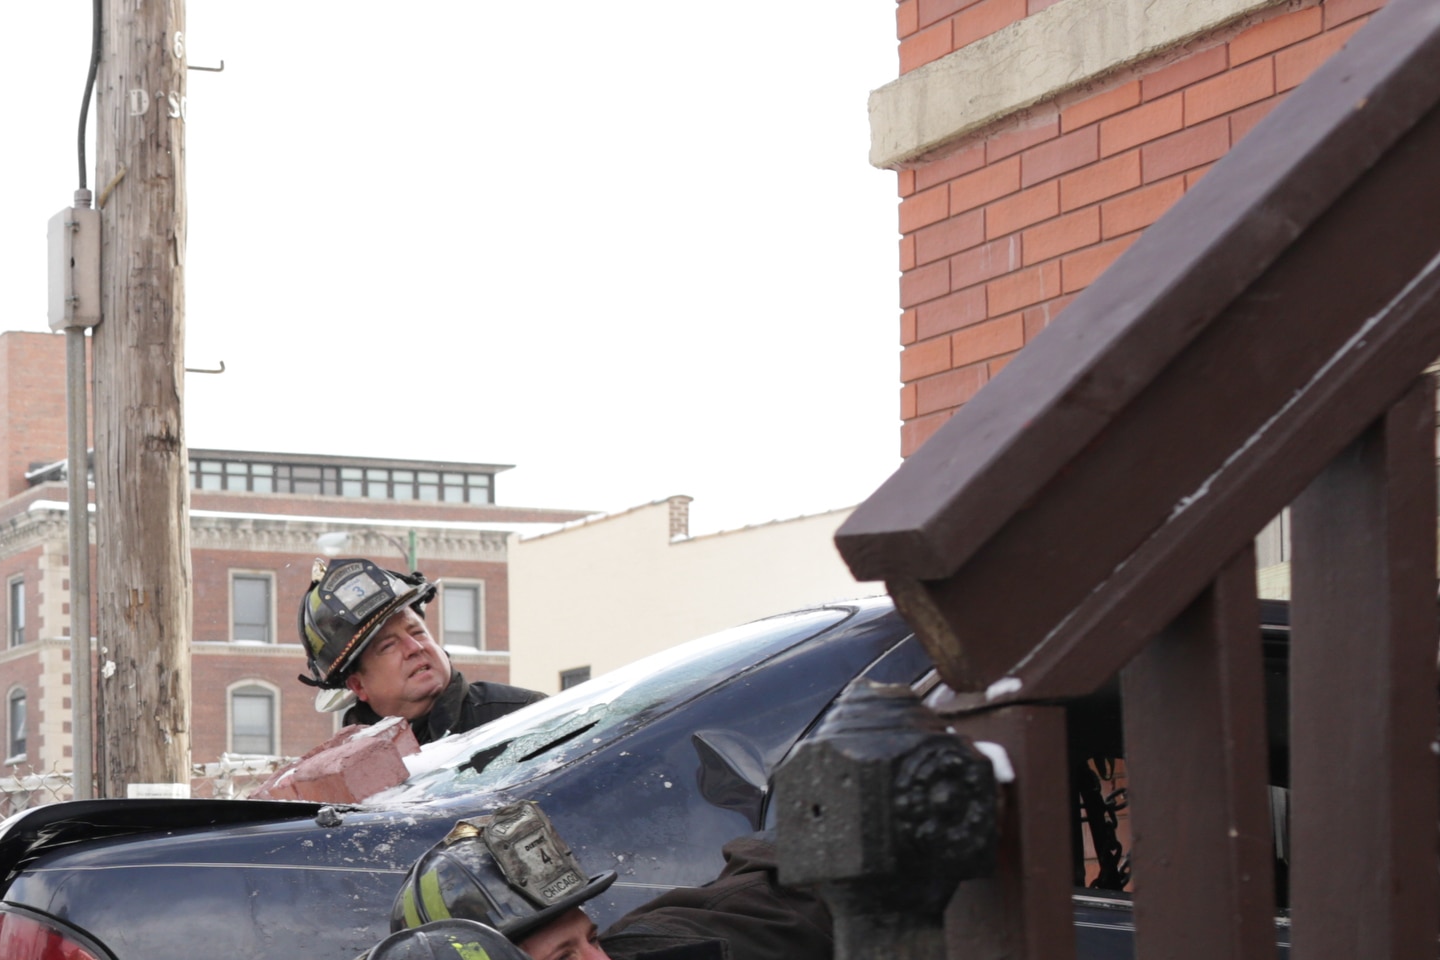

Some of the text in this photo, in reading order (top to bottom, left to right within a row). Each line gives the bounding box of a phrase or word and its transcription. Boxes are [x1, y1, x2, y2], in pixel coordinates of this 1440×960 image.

[173, 31, 183, 58] 6
[352, 585, 365, 597] 3
[540, 848, 553, 864] 4
[542, 873, 580, 898] CHICAGO
